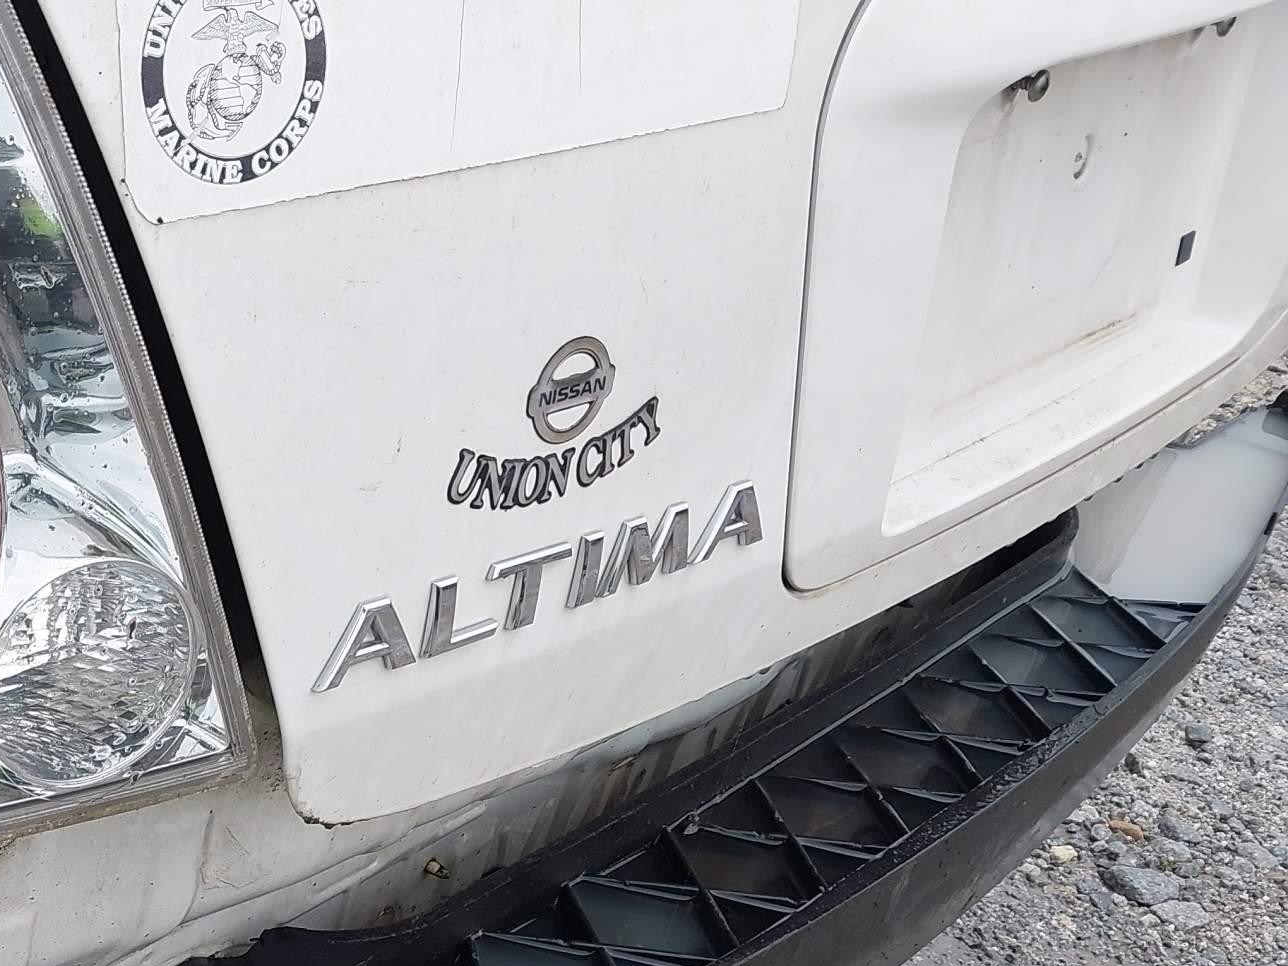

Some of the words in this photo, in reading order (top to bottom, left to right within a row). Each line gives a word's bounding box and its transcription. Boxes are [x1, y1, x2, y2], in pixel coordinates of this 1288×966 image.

[146, 98, 243, 183] MARINE
[251, 79, 324, 177] CORPS
[538, 375, 607, 408] NISSAN
[447, 448, 576, 511] UNION
[576, 396, 660, 488] CITY
[312, 479, 765, 694] ALTIMA
